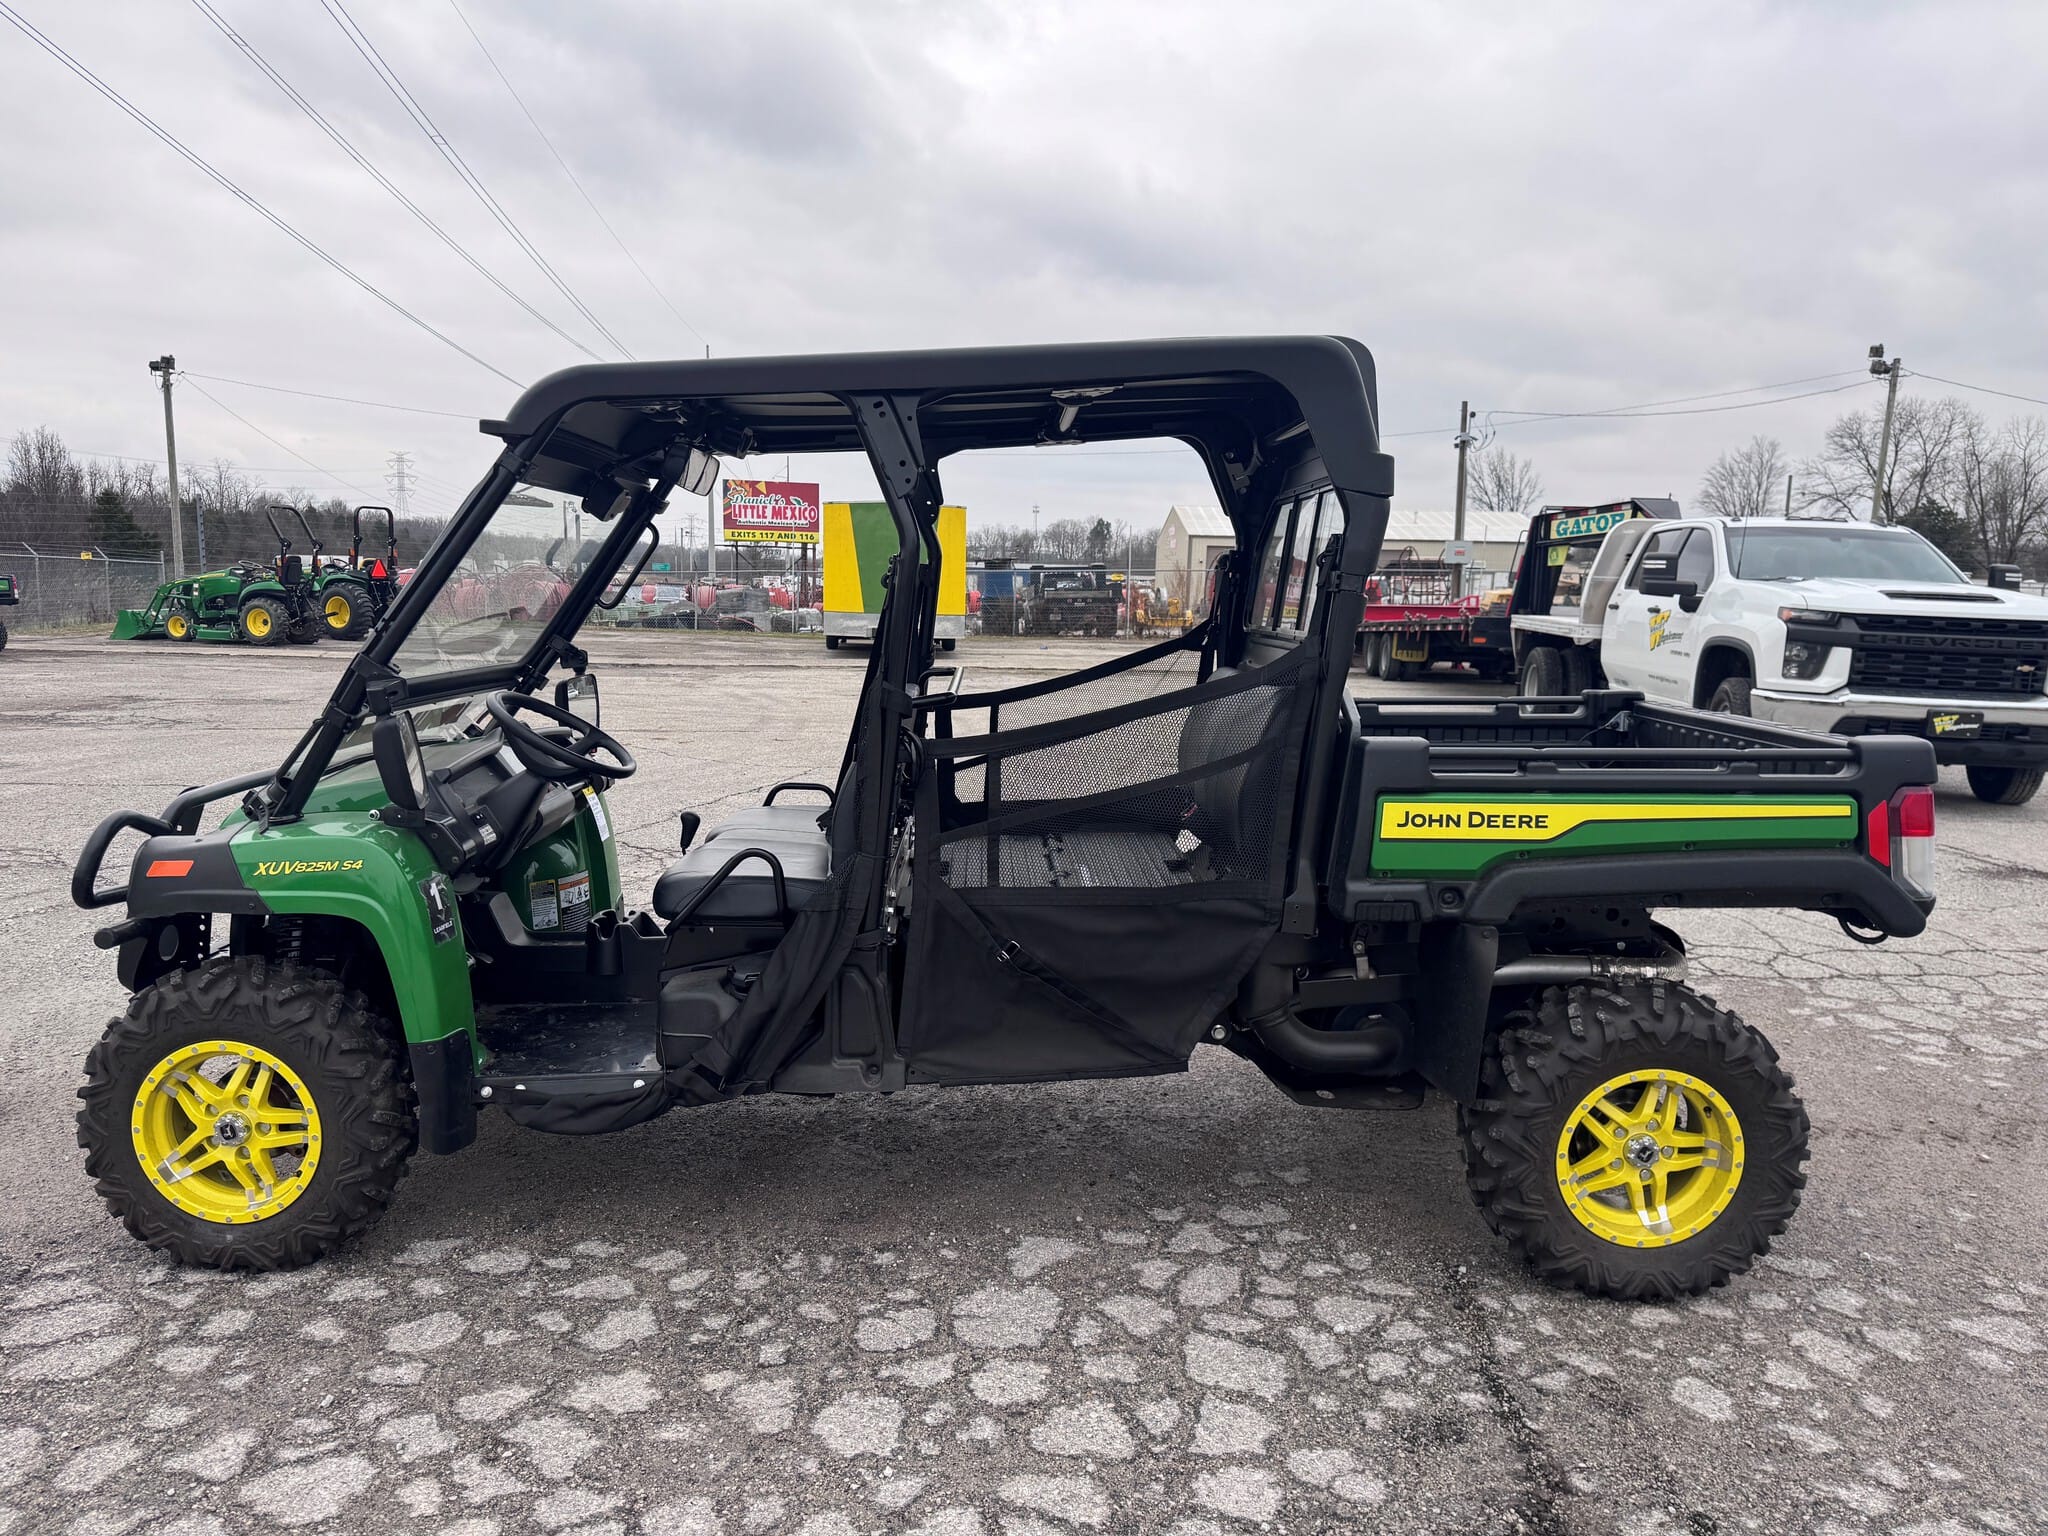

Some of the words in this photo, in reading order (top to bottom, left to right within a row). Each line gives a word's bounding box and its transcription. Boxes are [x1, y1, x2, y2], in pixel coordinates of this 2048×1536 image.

[731, 493, 786, 505] Daniel's
[732, 504, 767, 519] LITTLE
[771, 505, 817, 522] MEXICO
[253, 860, 340, 876] XUV825M
[341, 859, 364, 871] S4
